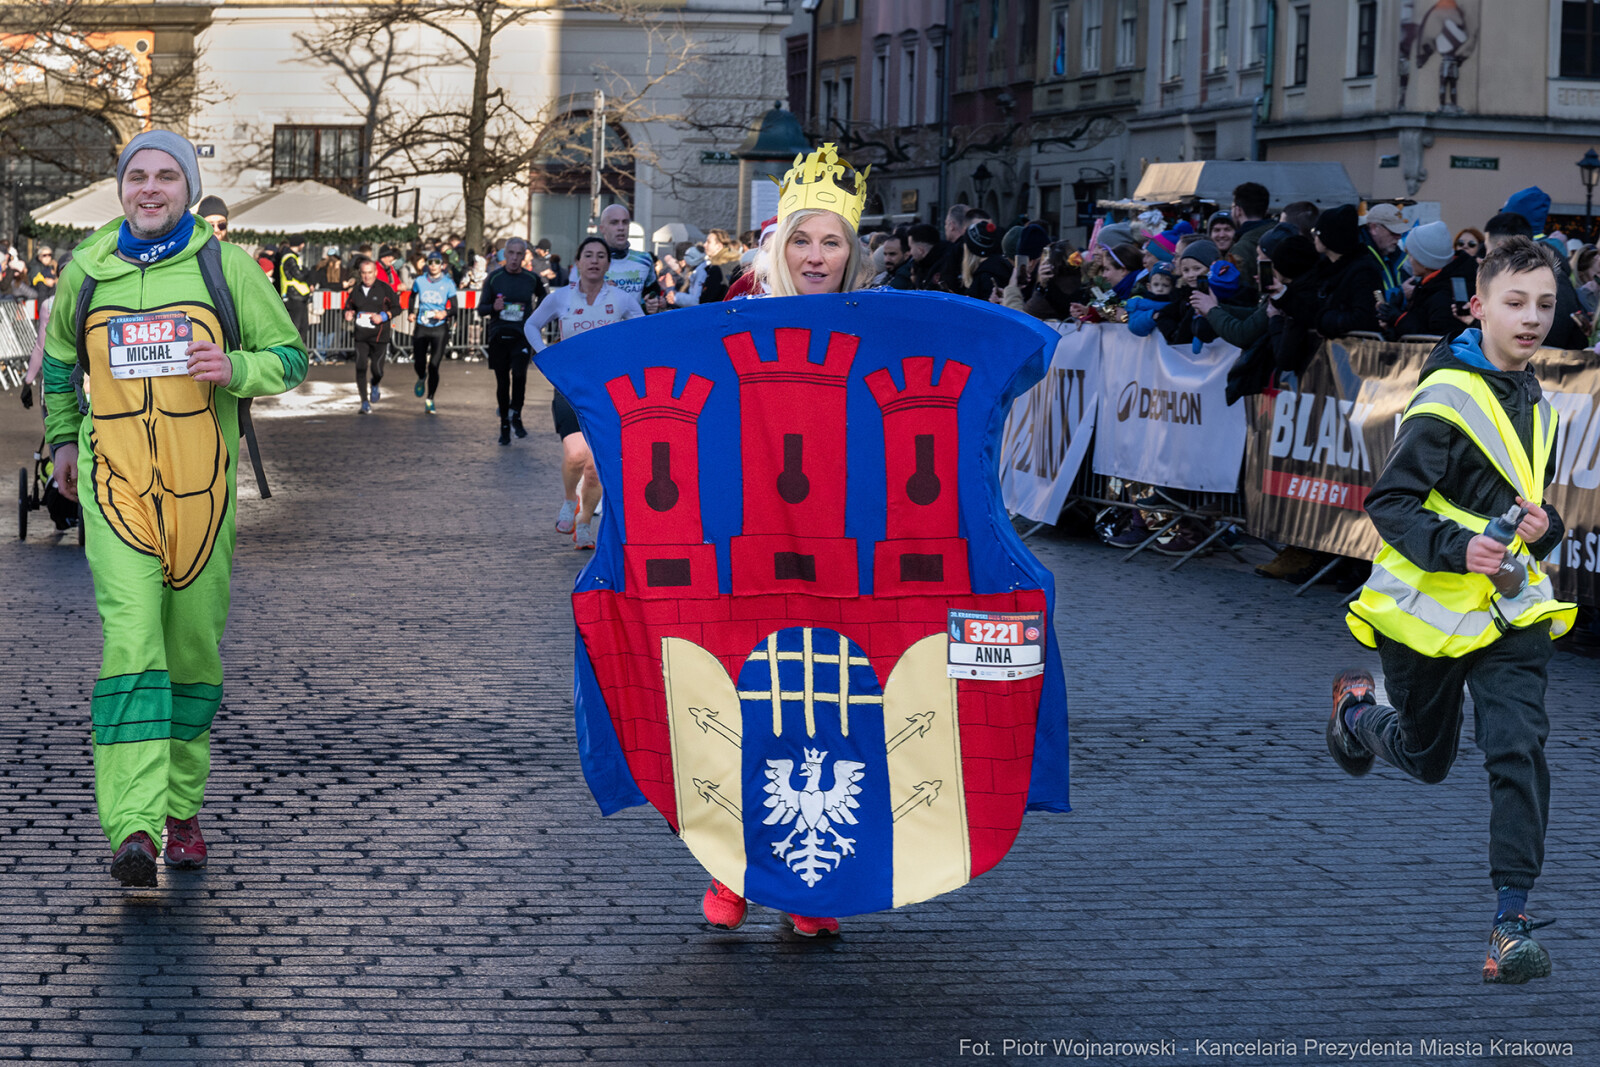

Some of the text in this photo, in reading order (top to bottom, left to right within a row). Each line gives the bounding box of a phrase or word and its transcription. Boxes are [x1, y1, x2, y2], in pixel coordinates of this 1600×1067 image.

[125, 321, 174, 344] 3452
[126, 344, 173, 362] MICHAŁ
[1268, 390, 1375, 472] BLACK
[1287, 477, 1349, 505] ENERGY
[958, 612, 988, 620] KRAKOWSKI
[969, 622, 1018, 644] 3221
[975, 646, 1012, 664] ANNA
